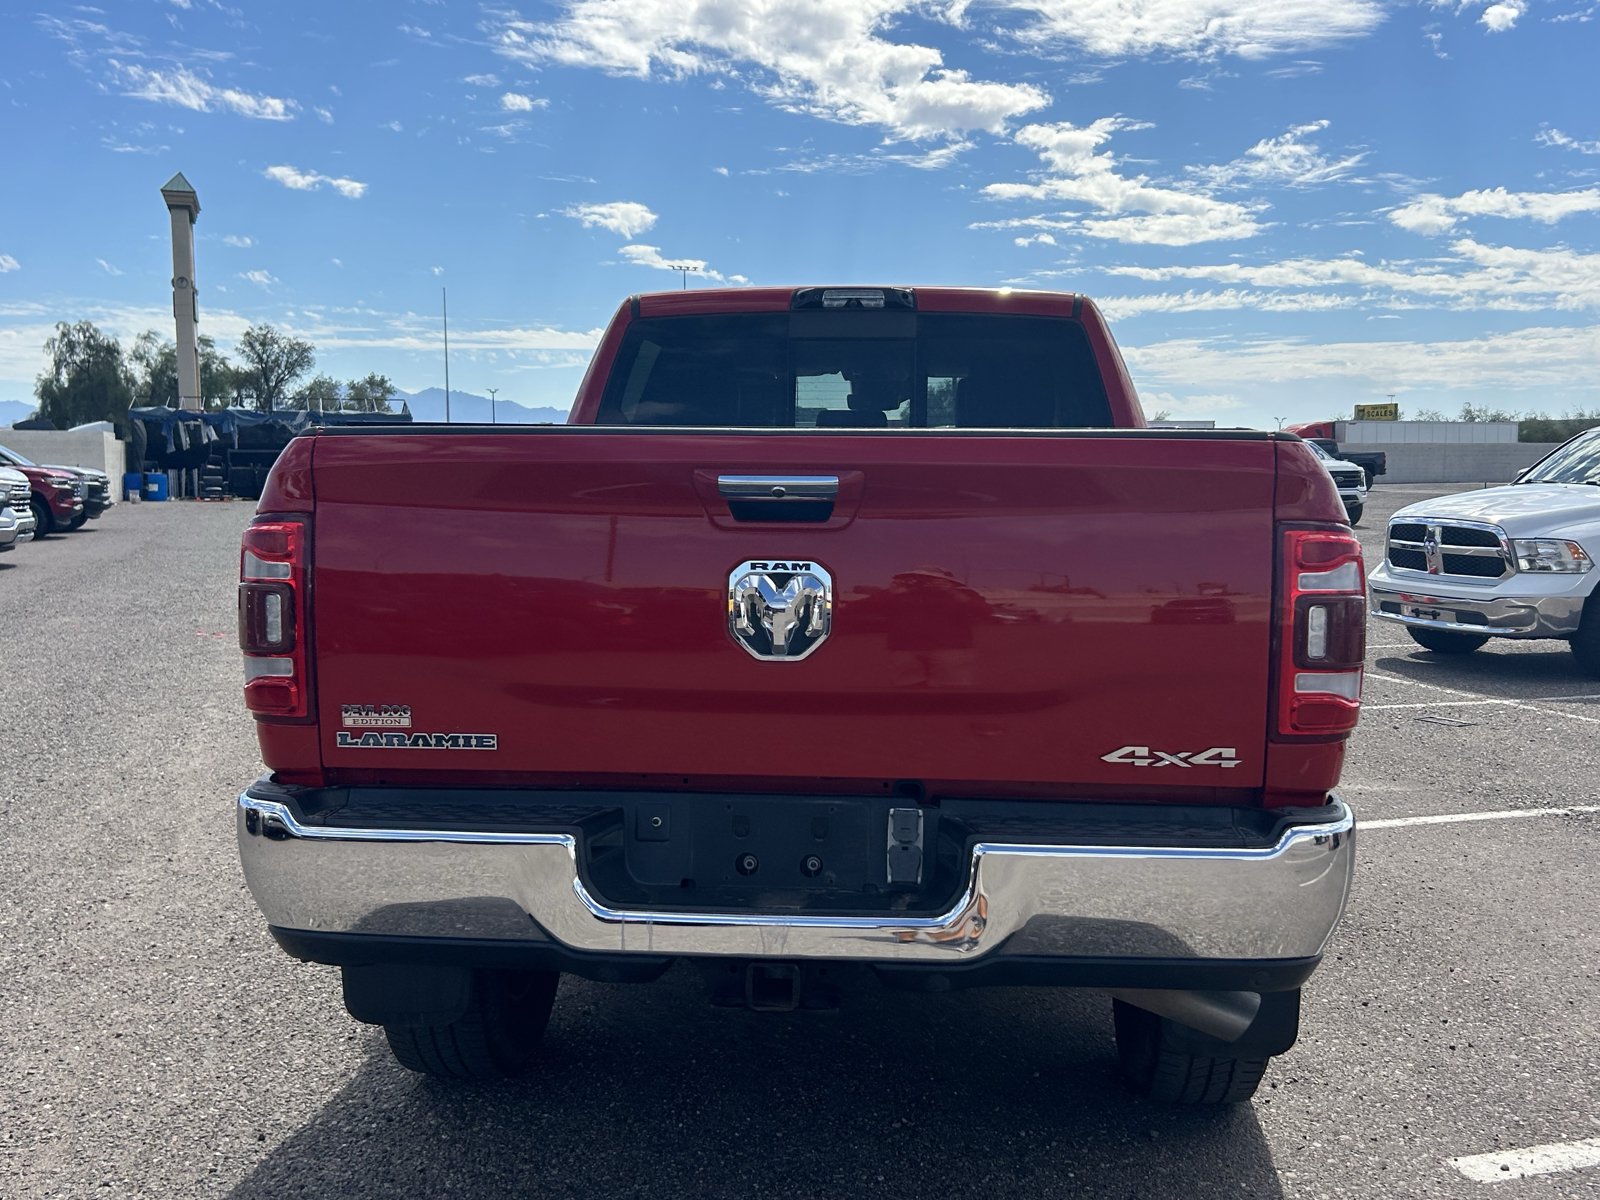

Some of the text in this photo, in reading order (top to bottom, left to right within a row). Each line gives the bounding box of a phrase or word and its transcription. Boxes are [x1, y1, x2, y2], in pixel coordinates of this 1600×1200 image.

[1366, 409, 1393, 417] SCALES
[750, 562, 811, 571] RAM
[341, 704, 411, 717] DEVIL DOG
[336, 731, 498, 751] LARAMIE
